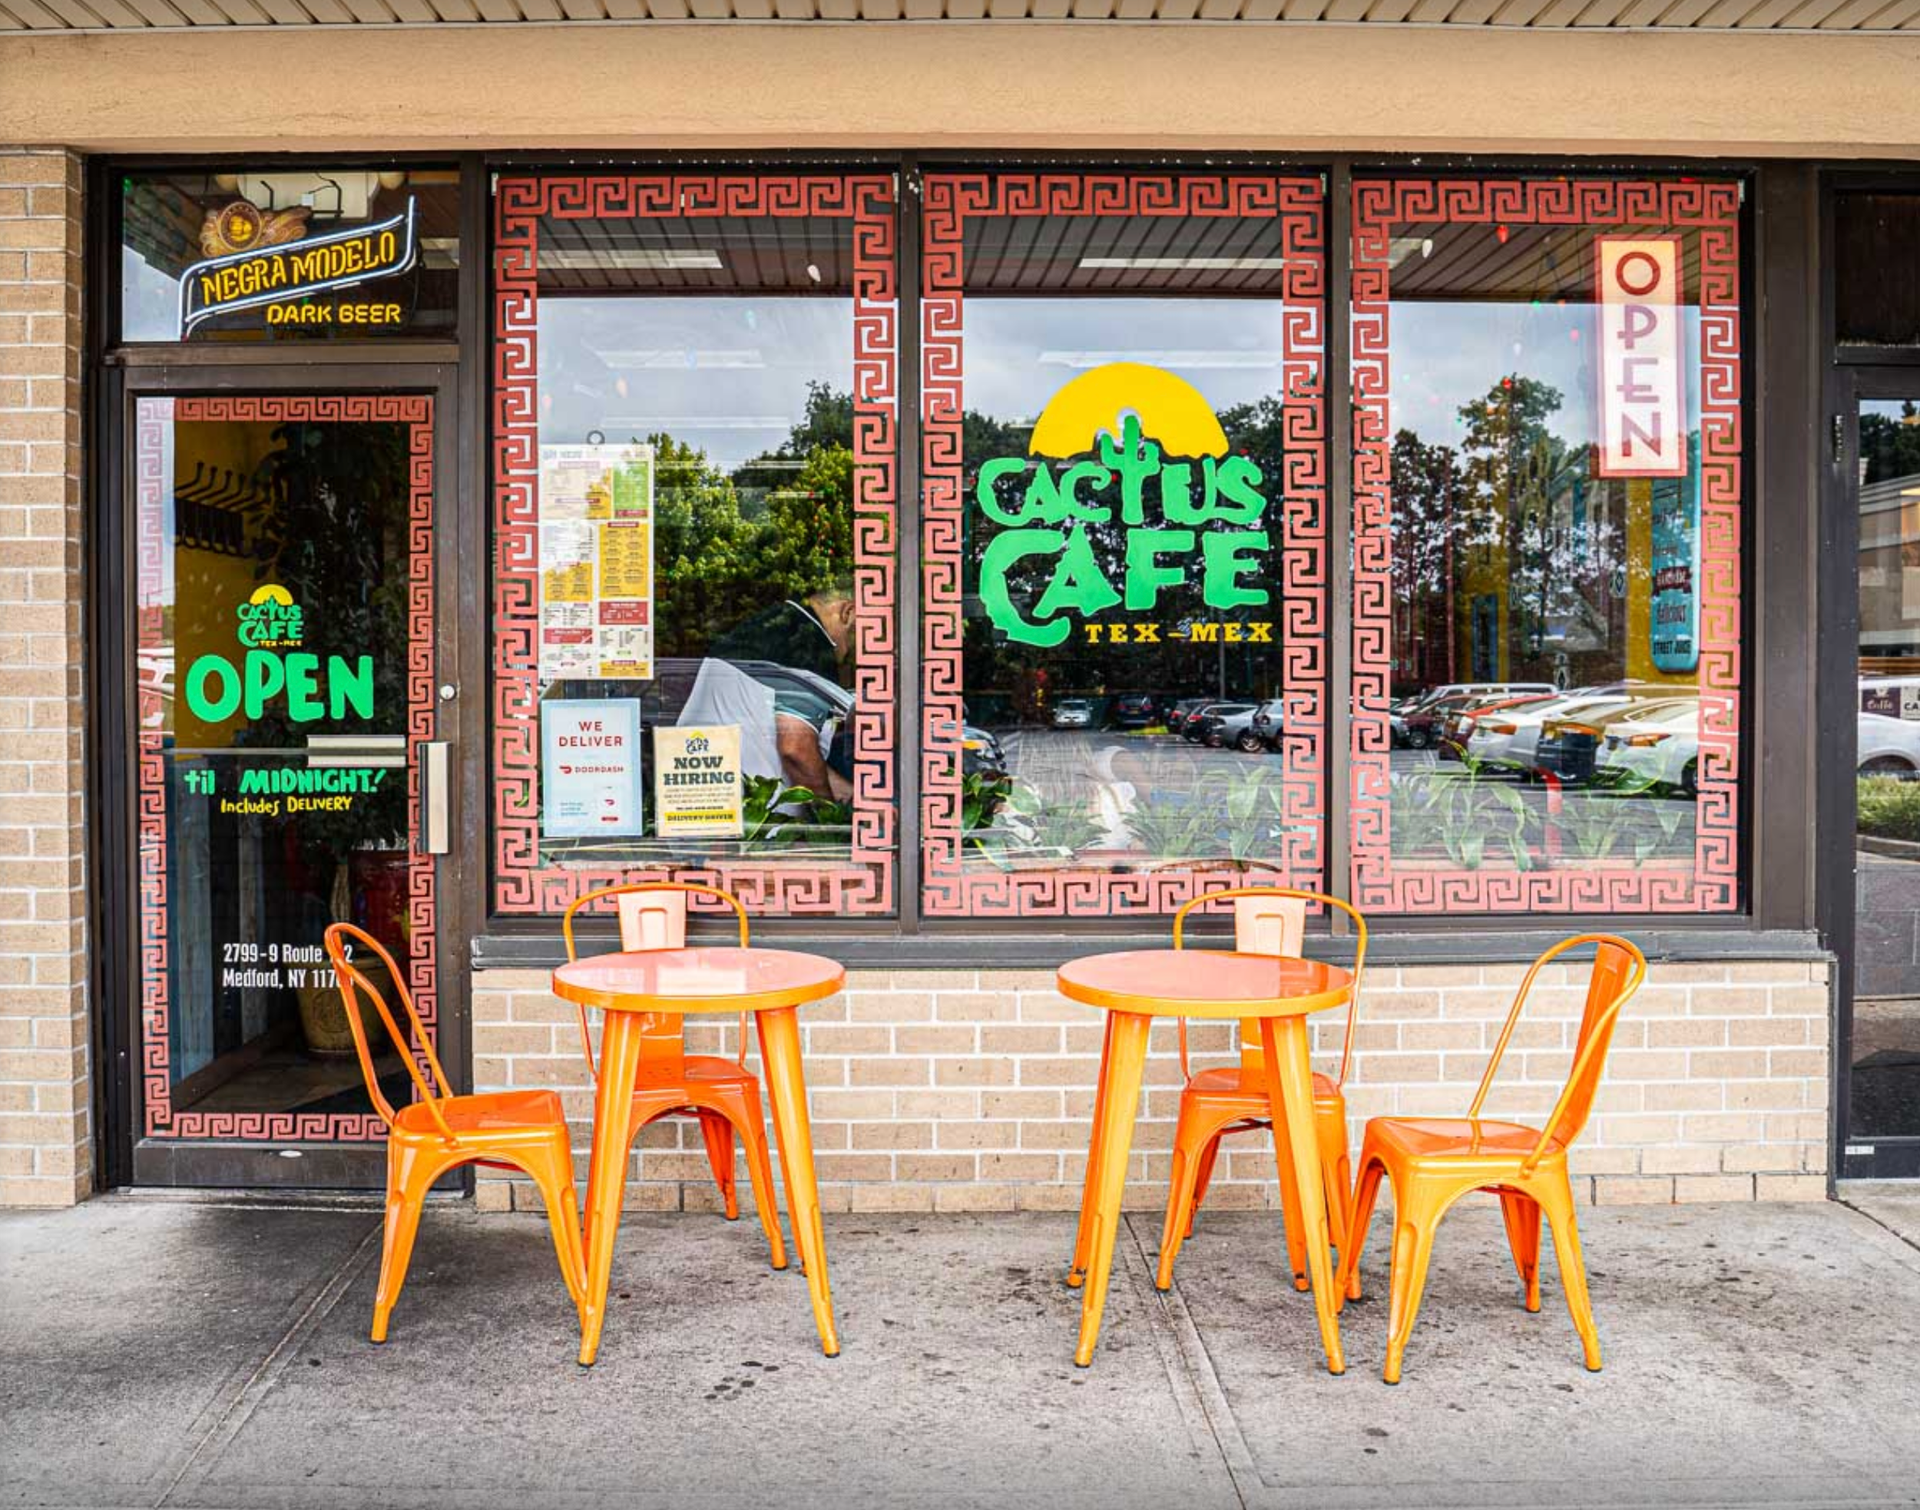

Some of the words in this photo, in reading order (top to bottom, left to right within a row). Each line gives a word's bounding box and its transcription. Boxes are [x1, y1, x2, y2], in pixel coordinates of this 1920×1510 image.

[200, 254, 287, 306] NEGRA
[291, 231, 396, 286] MODELO
[267, 304, 333, 325] DARK
[339, 304, 401, 324] BEER
[1615, 252, 1662, 459] OPEN
[976, 414, 1267, 526] CACTUS
[979, 524, 1270, 648] CAFE
[236, 594, 302, 620] CACTUS
[237, 620, 304, 647] CAFE
[185, 649, 374, 722] OPEN
[578, 721, 603, 732] WE
[558, 736, 623, 747] DELIVER
[575, 766, 624, 774] DOORDASH
[673, 756, 724, 769] NOW
[239, 768, 387, 794] MIDNIGHT!
[663, 772, 735, 786] HIRING
[221, 797, 280, 816] Includes
[287, 796, 353, 813] DELIVERY
[223, 943, 279, 963] 2799-9
[282, 944, 323, 963] Route
[222, 968, 284, 989] Medford,
[288, 969, 307, 988] NY
